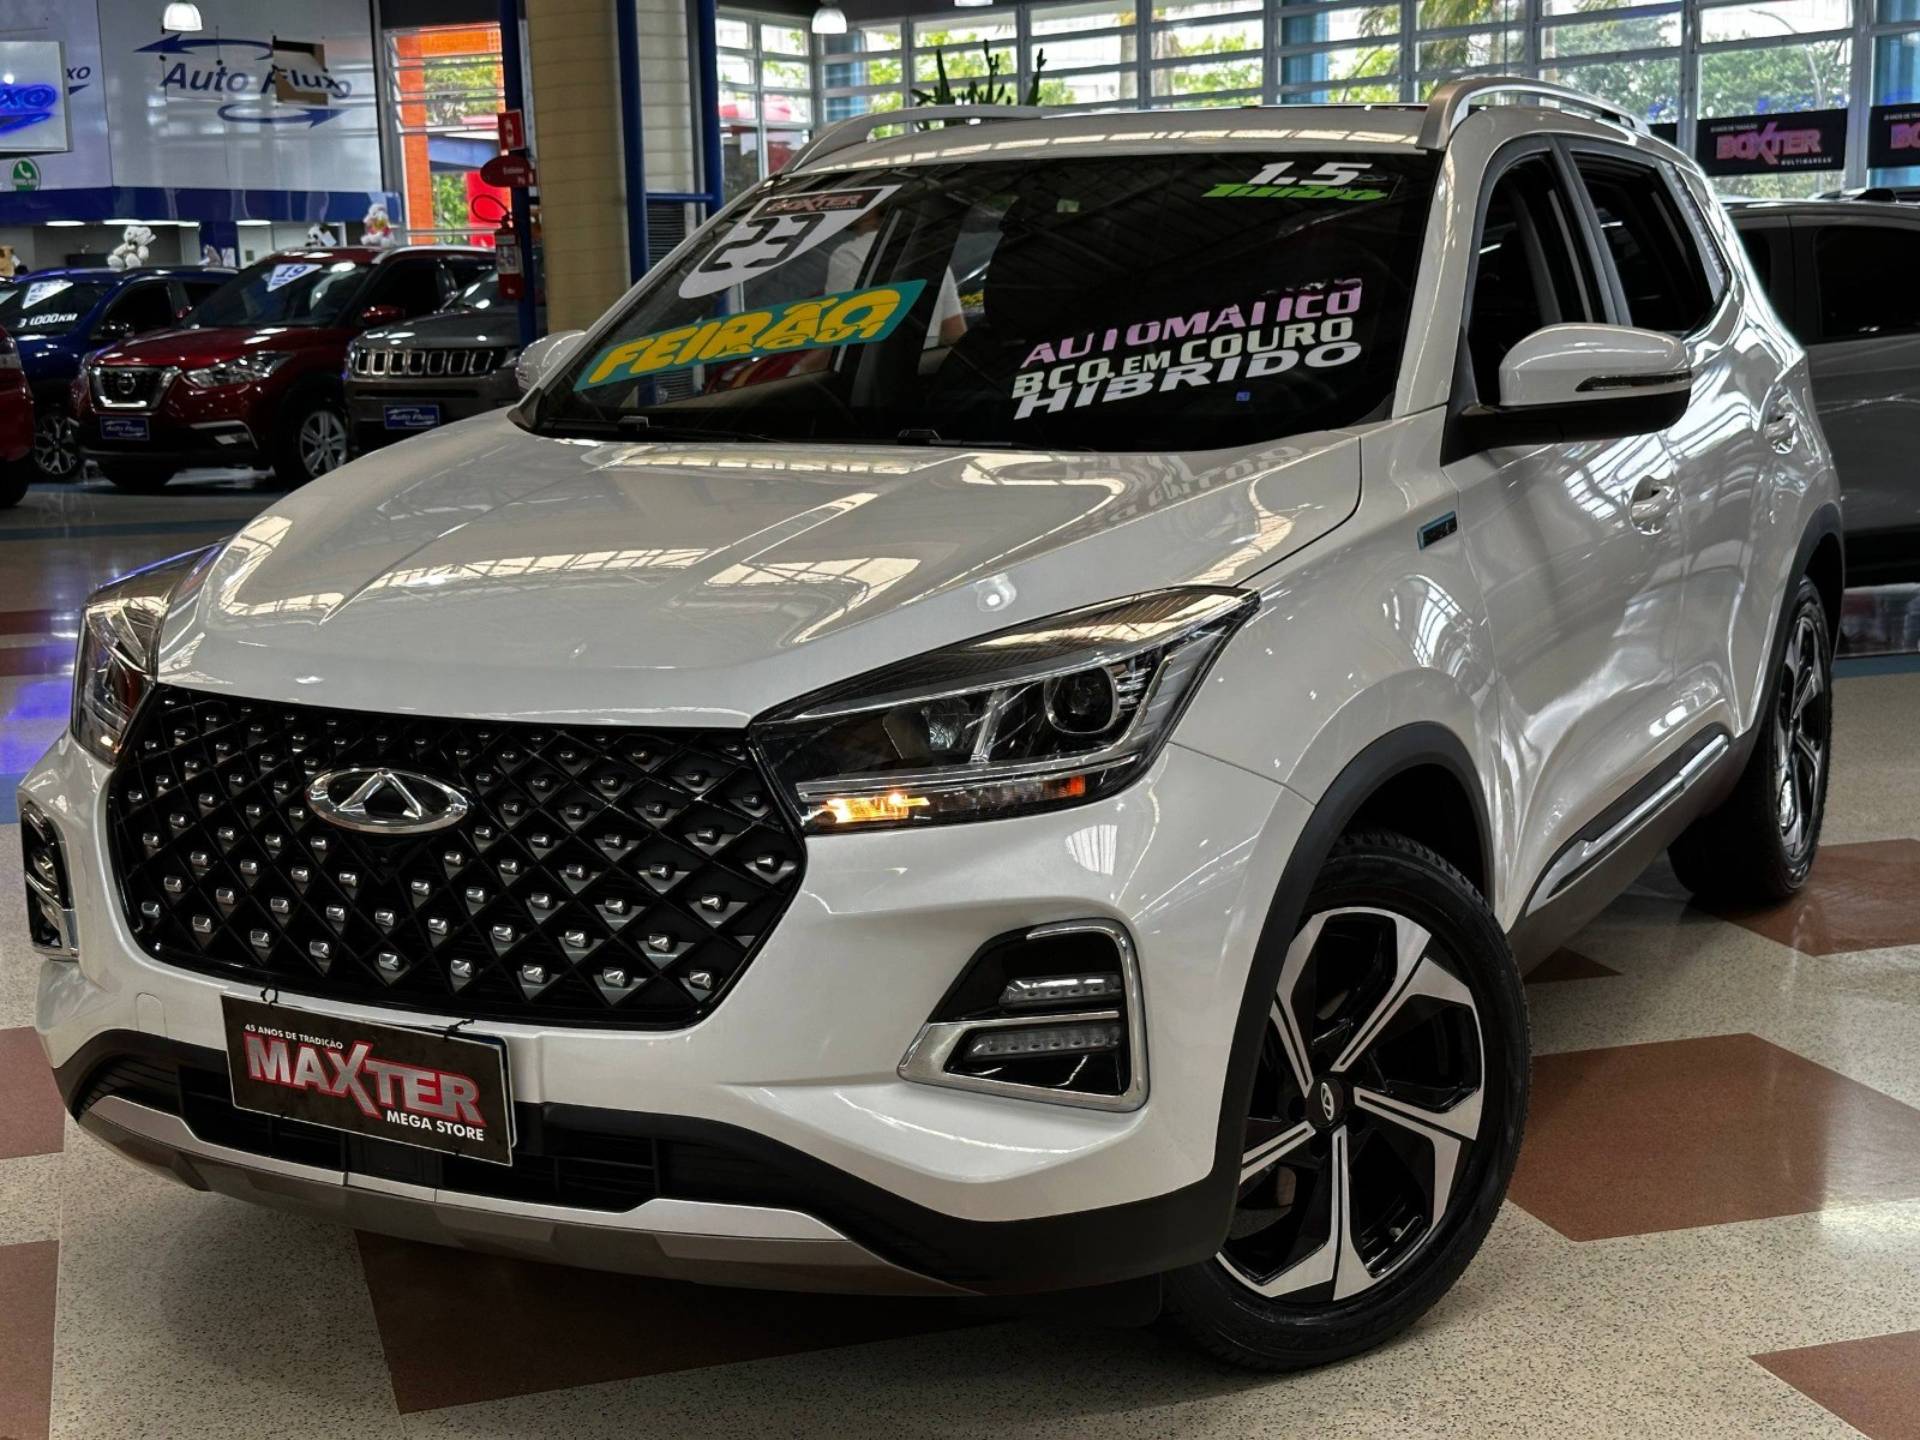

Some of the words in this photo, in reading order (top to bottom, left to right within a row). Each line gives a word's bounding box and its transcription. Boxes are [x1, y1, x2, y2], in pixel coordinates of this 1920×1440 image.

[160, 62, 249, 92] Auto
[1716, 121, 1821, 165] BOXTER
[1247, 161, 1373, 187] 1.5
[698, 213, 826, 273] 23
[588, 289, 901, 384] FEIRÃO
[1122, 350, 1171, 377] EM
[1179, 317, 1353, 366] COURO
[1014, 341, 1361, 420] HIBRIDO
[244, 1023, 256, 1034] 45
[258, 1026, 284, 1039] ANOS
[285, 1031, 297, 1040] DE
[244, 1033, 487, 1127] MAXTER
[387, 1110, 432, 1132] MEGA
[436, 1120, 485, 1142] STORE
